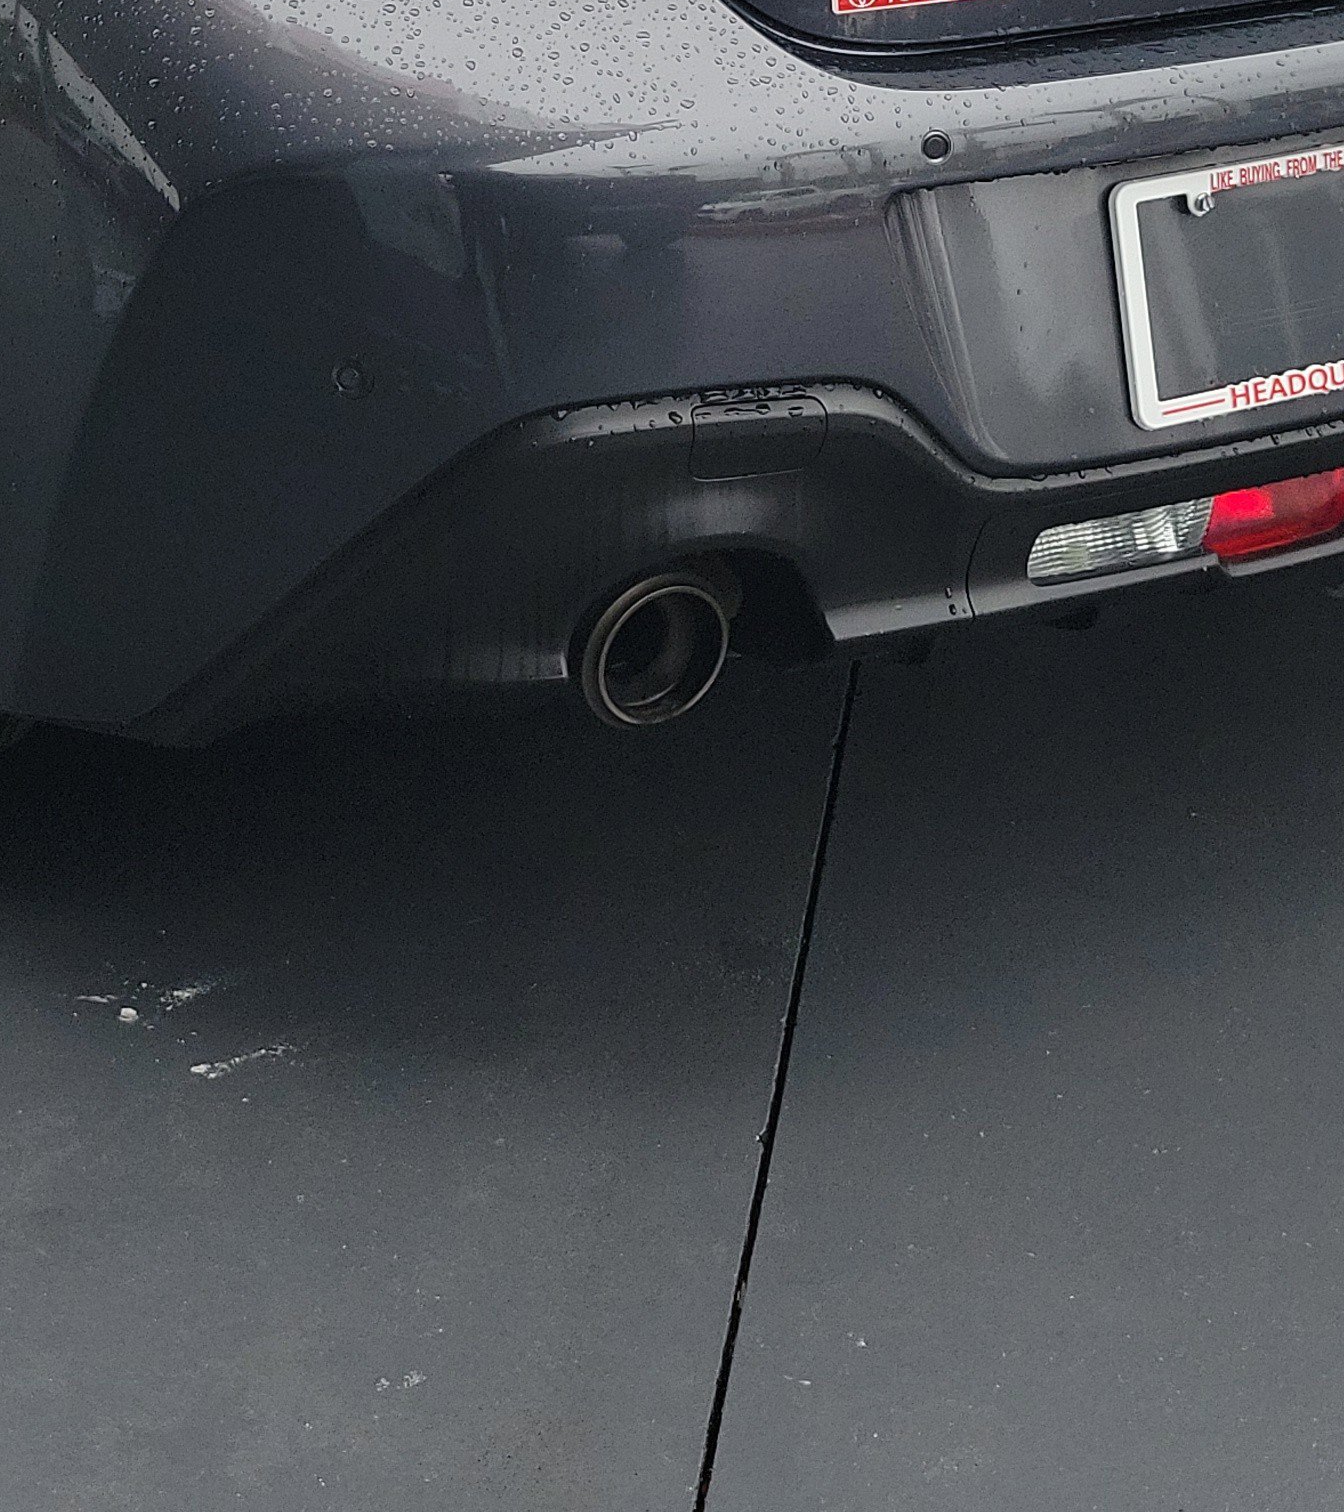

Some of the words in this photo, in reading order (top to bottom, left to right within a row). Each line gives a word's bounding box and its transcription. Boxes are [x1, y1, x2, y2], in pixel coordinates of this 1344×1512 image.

[1210, 170, 1235, 191] LIKE
[1240, 162, 1281, 185] BUYING
[1287, 155, 1317, 177] FROM
[1323, 151, 1343, 170] THE
